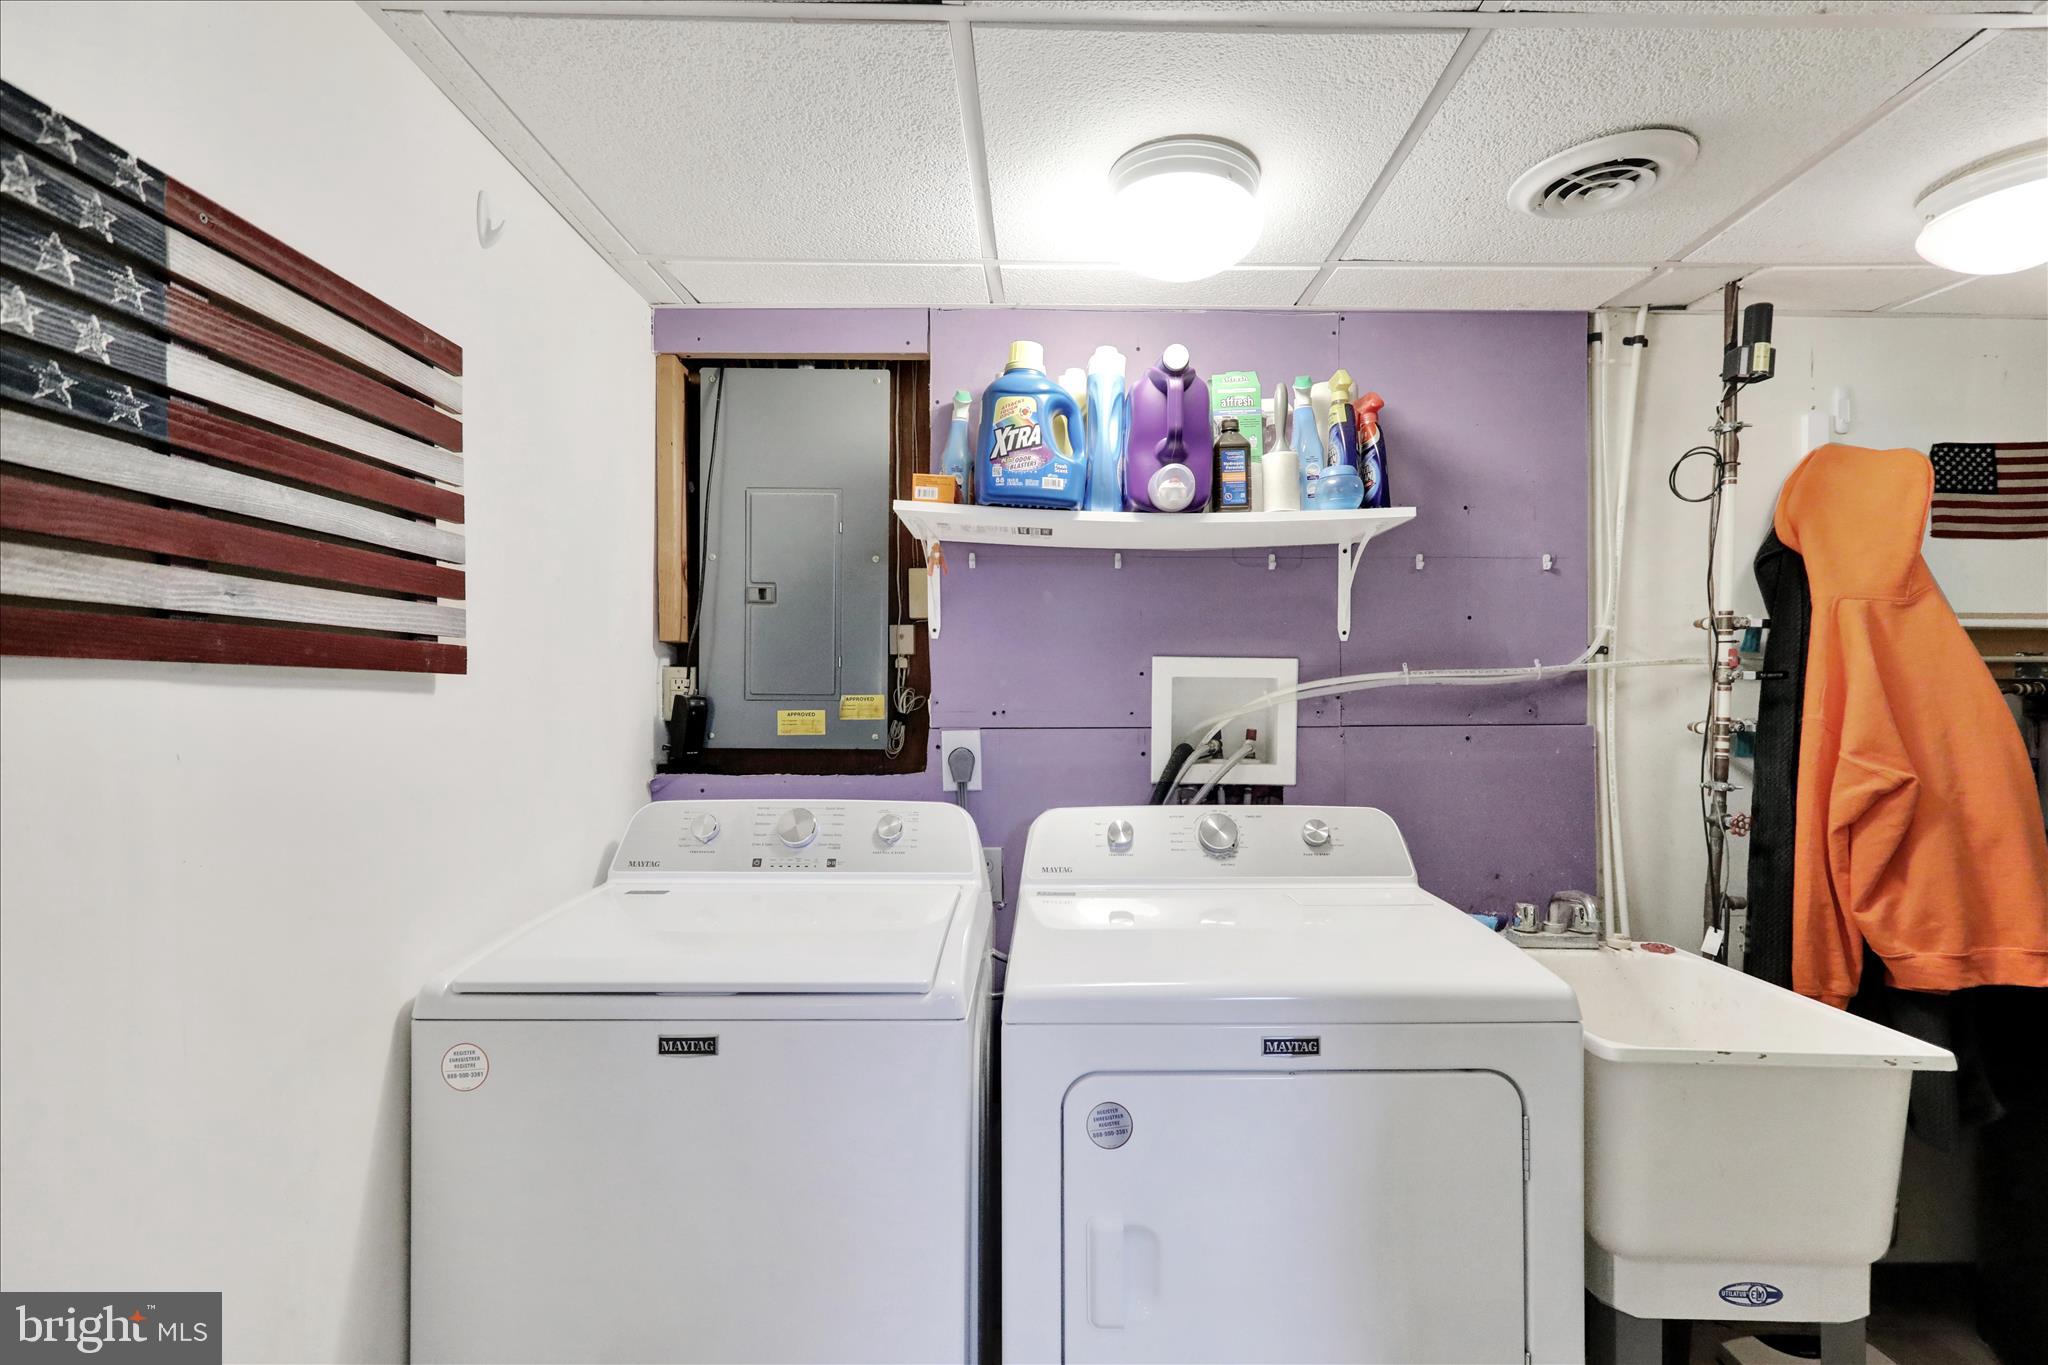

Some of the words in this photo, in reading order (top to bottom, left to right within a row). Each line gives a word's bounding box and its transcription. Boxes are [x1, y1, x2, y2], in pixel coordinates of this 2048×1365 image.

[1220, 396, 1254, 408] affresh
[990, 424, 1042, 460] XTRA
[628, 860, 660, 868] MAYTAG
[661, 1040, 716, 1052] MAYTAG
[1265, 1041, 1318, 1053] MAYTAG
